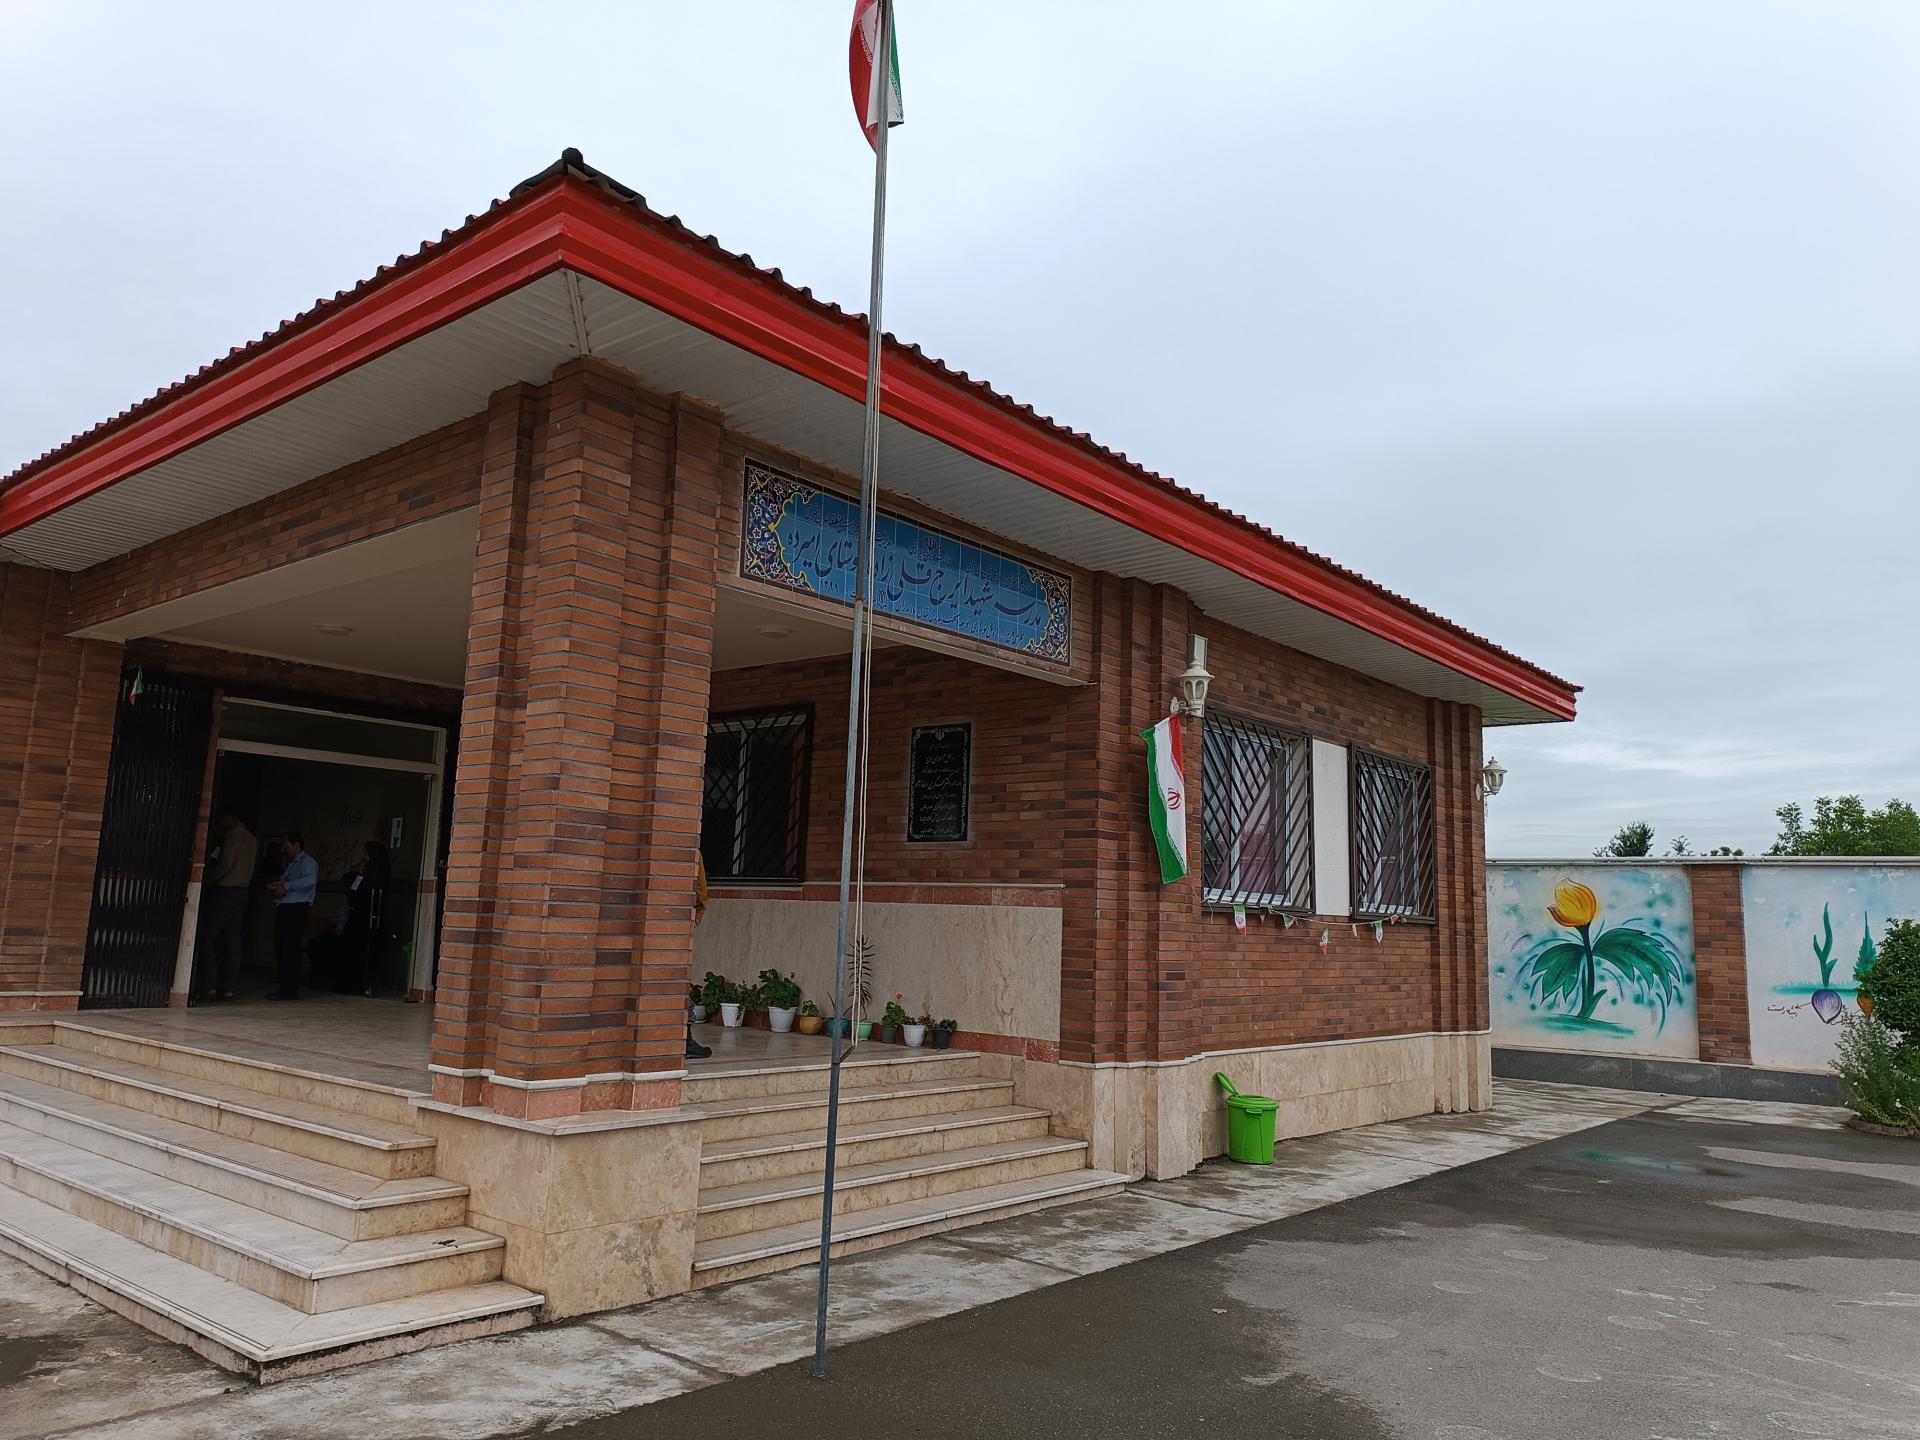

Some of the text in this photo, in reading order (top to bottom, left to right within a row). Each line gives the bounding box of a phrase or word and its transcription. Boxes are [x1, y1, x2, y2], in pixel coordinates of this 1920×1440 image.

[787, 530, 821, 567] امیرده
[815, 537, 858, 578] وستای
[886, 557, 932, 603] قلی
[928, 568, 969, 610] ایرج
[963, 580, 993, 617] شهید
[992, 600, 1041, 626] مدرسه
